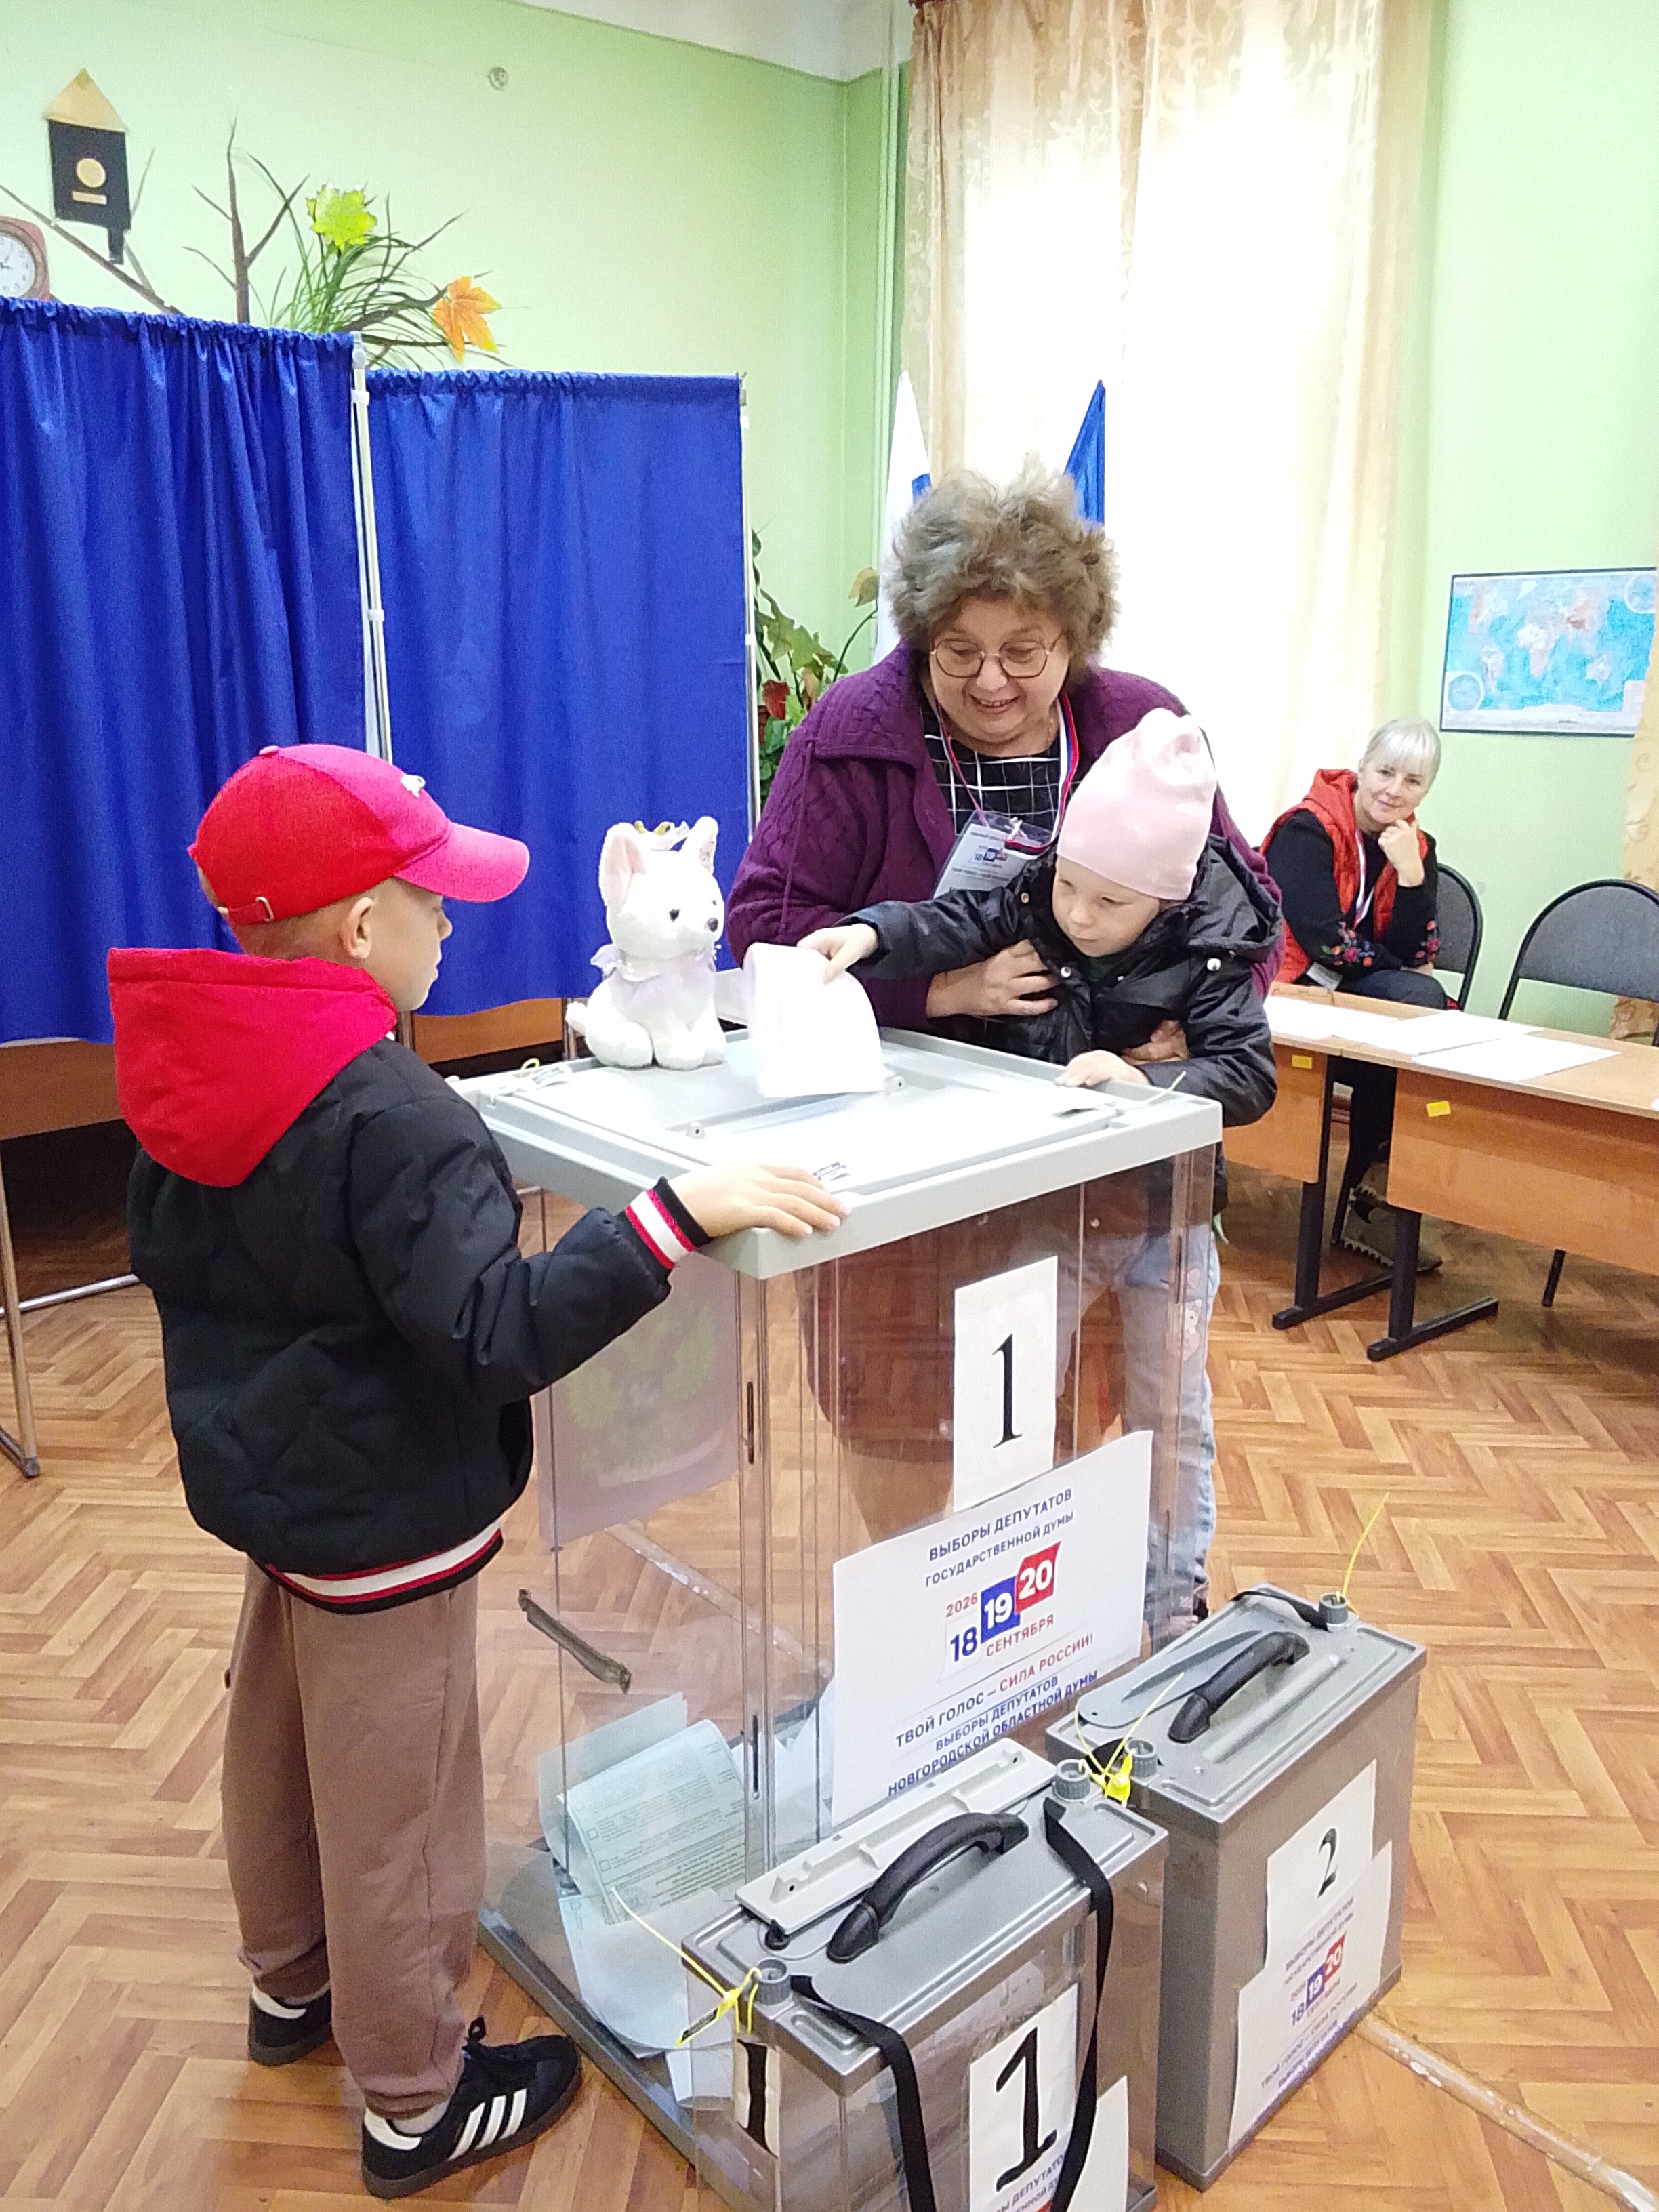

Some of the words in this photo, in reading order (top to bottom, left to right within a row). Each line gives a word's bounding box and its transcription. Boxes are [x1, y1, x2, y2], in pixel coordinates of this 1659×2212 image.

[993, 1333, 1023, 1449] 1
[926, 1526, 1040, 1587] ГОСУДАРСТВЕННОЙ
[1043, 1511, 1073, 1536] ДУМЫ
[929, 1523, 990, 1561] ВЫБОРЫ
[994, 1488, 1072, 1534] ДЕПУТАТОВ
[946, 1592, 977, 1618] 2026
[950, 1626, 977, 1662] 18
[984, 1593, 1012, 1629] 19
[1019, 1560, 1052, 1600] 20
[986, 1614, 1054, 1657] СЕНТЯБРЯ
[896, 1715, 935, 1748] ТВОЙ
[939, 1692, 984, 1726] ГОЛОС
[1000, 1665, 1036, 1692] СИЛА
[1039, 1633, 1092, 1672] РОССИИ!
[936, 1715, 989, 1751] ВЫБОРЫ
[991, 1676, 1059, 1722] ДЕПУТАТОВ
[888, 1728, 989, 1797] НОВГОРОДСКОЙ
[993, 1687, 1062, 1737] ОБЛАСТНОЙ
[1065, 1670, 1098, 1698] ДУМЫ
[1317, 1828, 1338, 1898] 2
[1292, 2001, 1305, 2026] 18
[1309, 1975, 1322, 2000] 19
[1325, 1946, 1343, 1975] 20
[996, 2026, 1057, 2192] 1
[1012, 2154, 1063, 2206] ДЕПУТАТО
